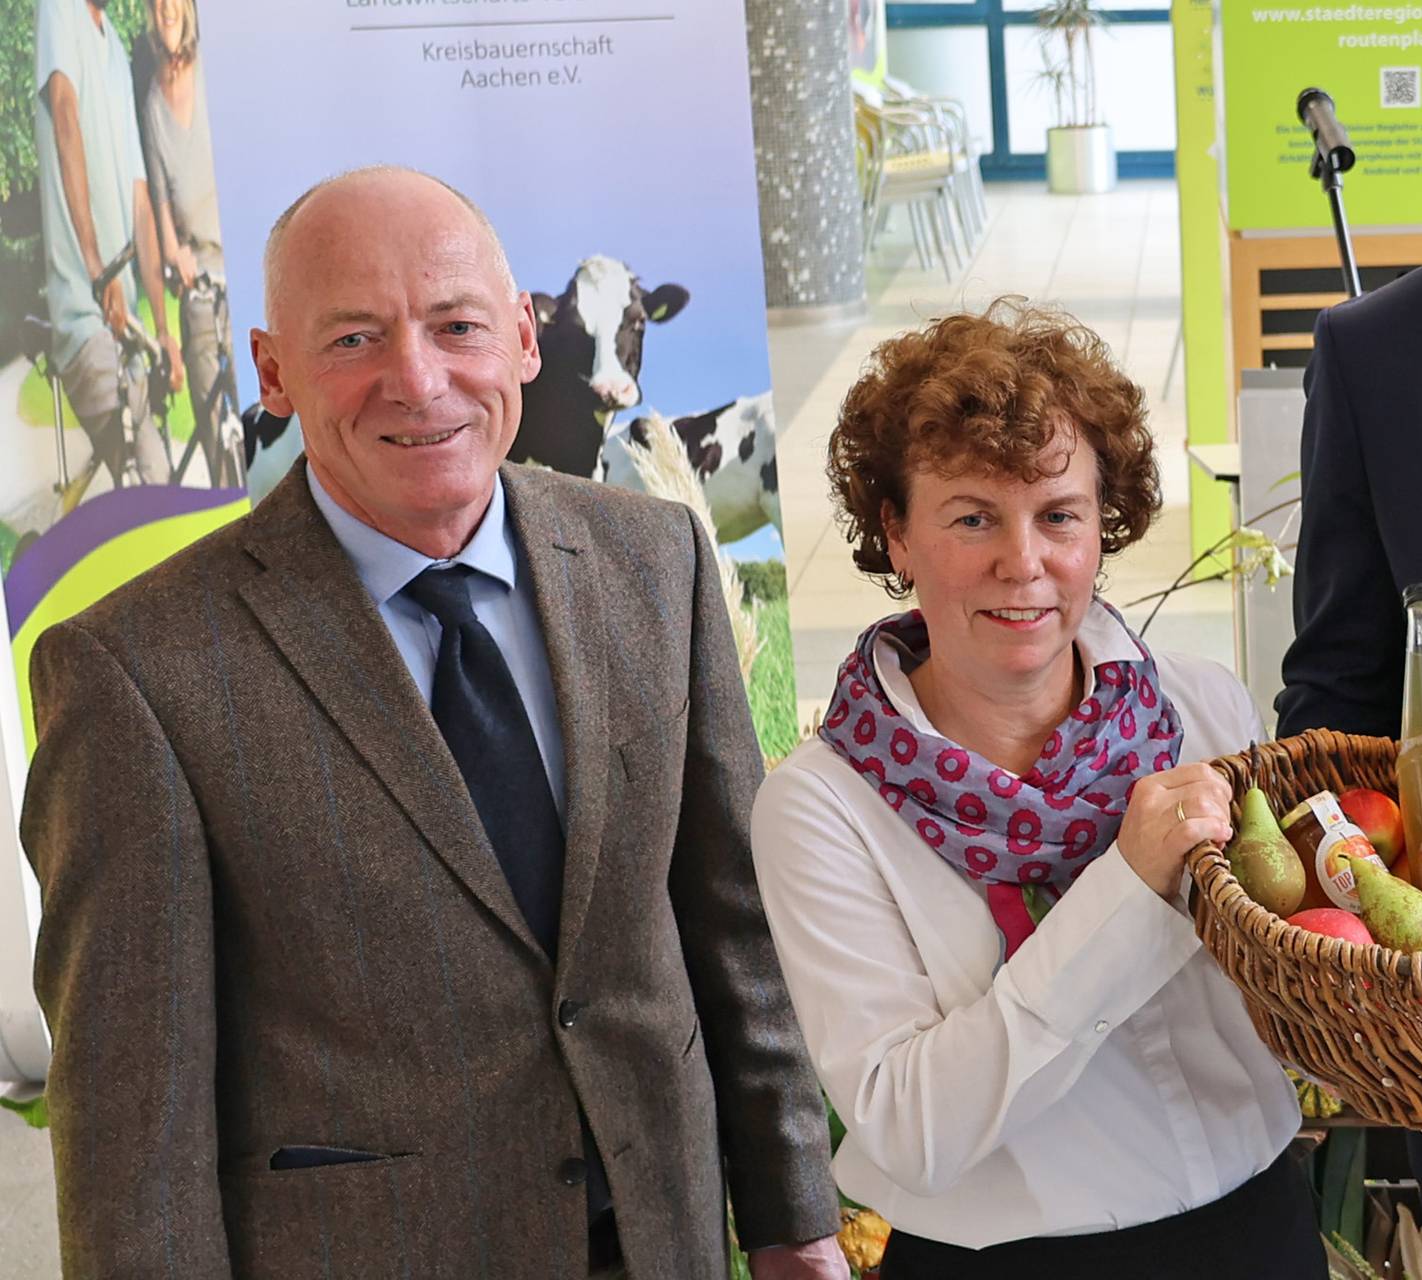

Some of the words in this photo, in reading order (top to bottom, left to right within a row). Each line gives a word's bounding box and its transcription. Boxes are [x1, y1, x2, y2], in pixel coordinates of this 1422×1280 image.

[422, 35, 614, 62] Kreisbauernschaft
[460, 67, 541, 89] Aachen
[548, 65, 581, 86] e.V.
